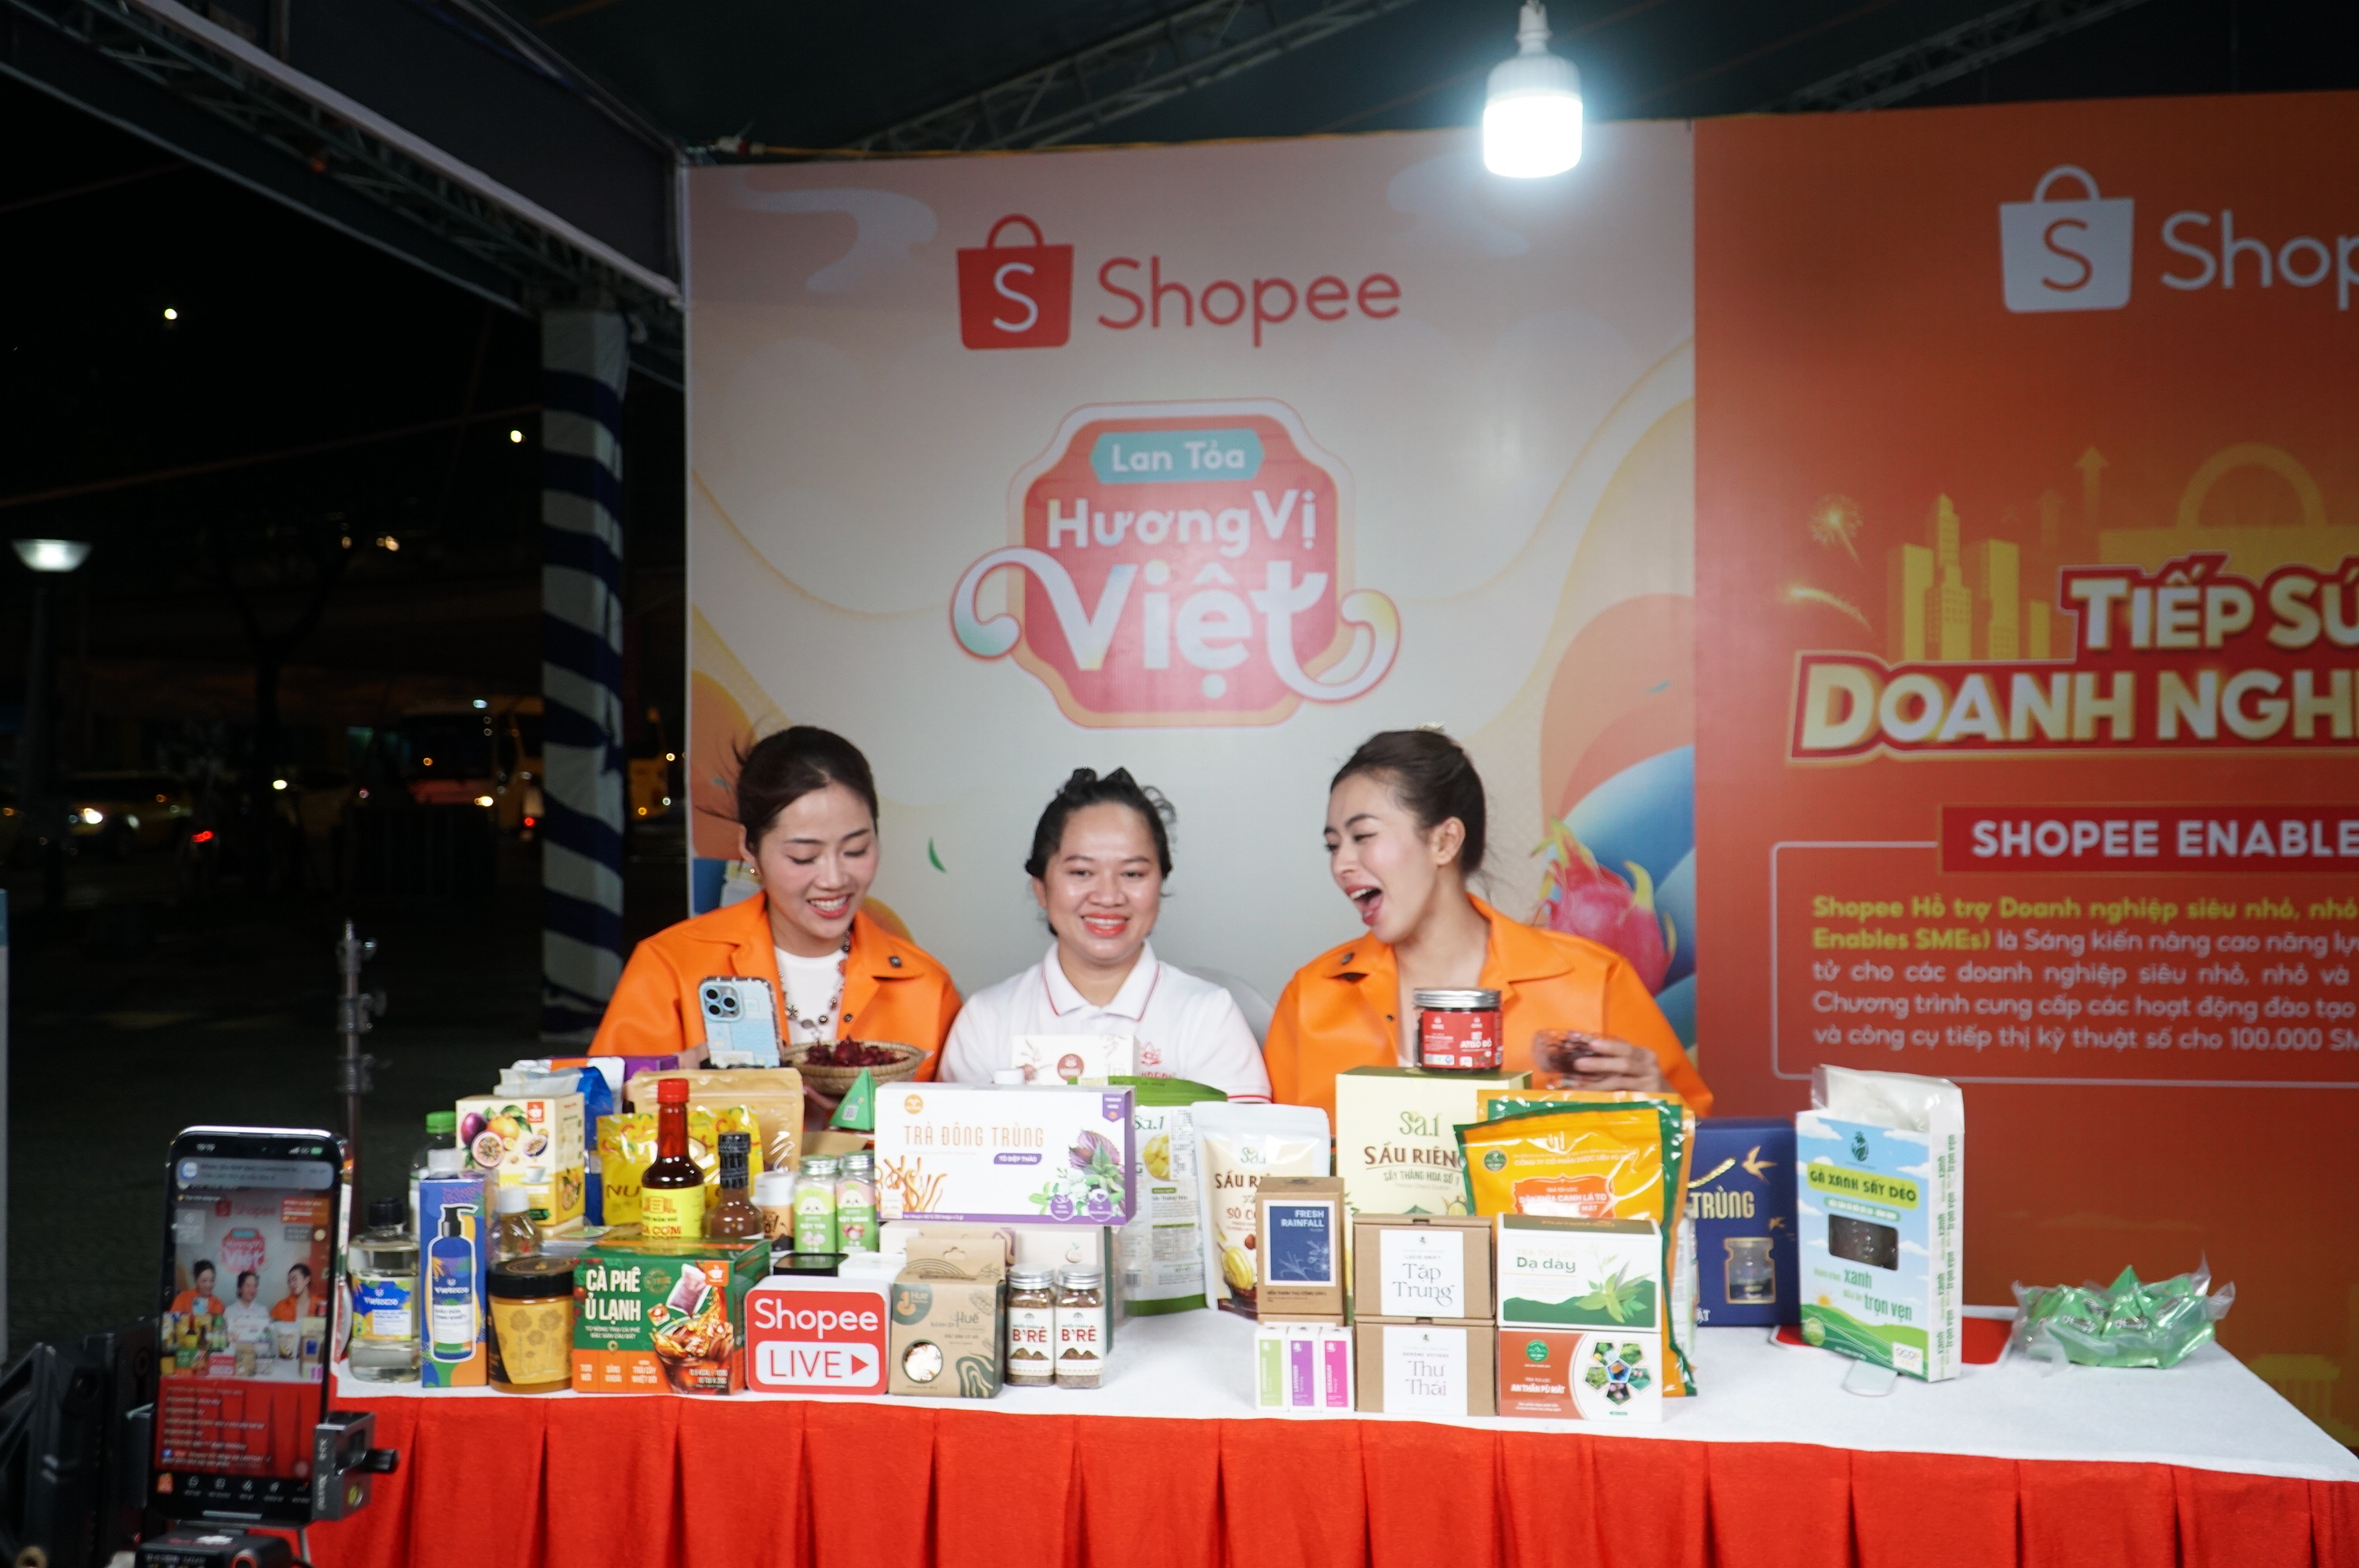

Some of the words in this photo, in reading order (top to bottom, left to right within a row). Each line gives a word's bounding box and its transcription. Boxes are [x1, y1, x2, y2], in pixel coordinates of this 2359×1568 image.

[1097, 256, 1401, 347] Shopee
[1111, 445, 1172, 472] Lan
[1184, 440, 1245, 469] Tỏa
[1047, 498, 1250, 557] Hương
[1252, 489, 1316, 549] Vị
[2071, 563, 2255, 649] TIẾP
[950, 546, 1401, 703] Việt
[1801, 664, 2137, 749] DOANH
[2157, 669, 2359, 740] NGH
[1972, 820, 2159, 858] SHOPEE
[2178, 819, 2359, 858] ENABLE
[1812, 895, 1904, 924] Shopee
[2000, 895, 2081, 919] Doanh
[1812, 927, 1909, 950] Enables
[2216, 934, 2260, 953] cao
[1850, 960, 1894, 982] cho
[1904, 960, 1946, 982] các
[1957, 960, 2032, 983] doanh
[1975, 997, 2033, 1021] cung
[1848, 1024, 1906, 1051] công
[2179, 1026, 2223, 1050] cho
[2230, 1026, 2323, 1051] 100.000
[904, 1121, 933, 1145] TRÀ
[942, 1122, 983, 1146] ĐÔNG
[992, 1123, 1044, 1147] TRÙNG
[1412, 1146, 1460, 1169] RIÊN
[1295, 1210, 1325, 1218] FRESH
[1688, 1185, 1755, 1219] TRÙNG
[1281, 1219, 1325, 1228] RAINFALL
[1517, 1257, 1538, 1272] Dạ
[1845, 1268, 1872, 1289] xanh
[587, 1265, 607, 1292] CÀ
[610, 1266, 642, 1293] PHÊ
[1392, 1281, 1455, 1308] Trung
[599, 1298, 642, 1326] LẠNH
[754, 1298, 879, 1339] Shopee
[769, 1348, 843, 1379] LIVE
